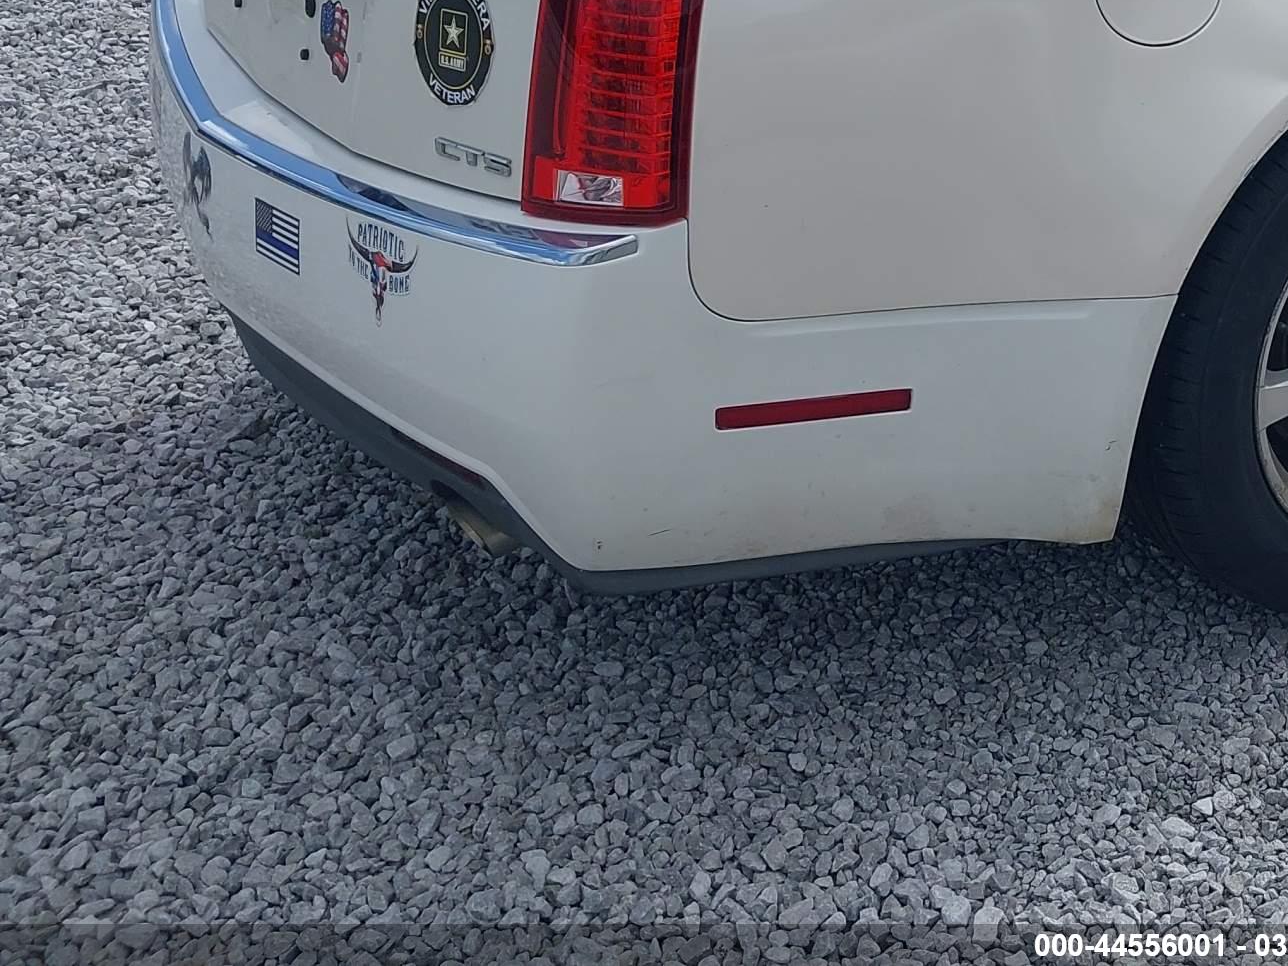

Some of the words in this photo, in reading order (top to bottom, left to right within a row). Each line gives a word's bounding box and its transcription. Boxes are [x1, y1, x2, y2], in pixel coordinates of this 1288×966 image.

[428, 73, 476, 104] VETERAN
[435, 136, 512, 177] CTS
[357, 223, 405, 263] PATRIOTIC
[357, 256, 369, 280] THE
[388, 274, 410, 294] BONE
